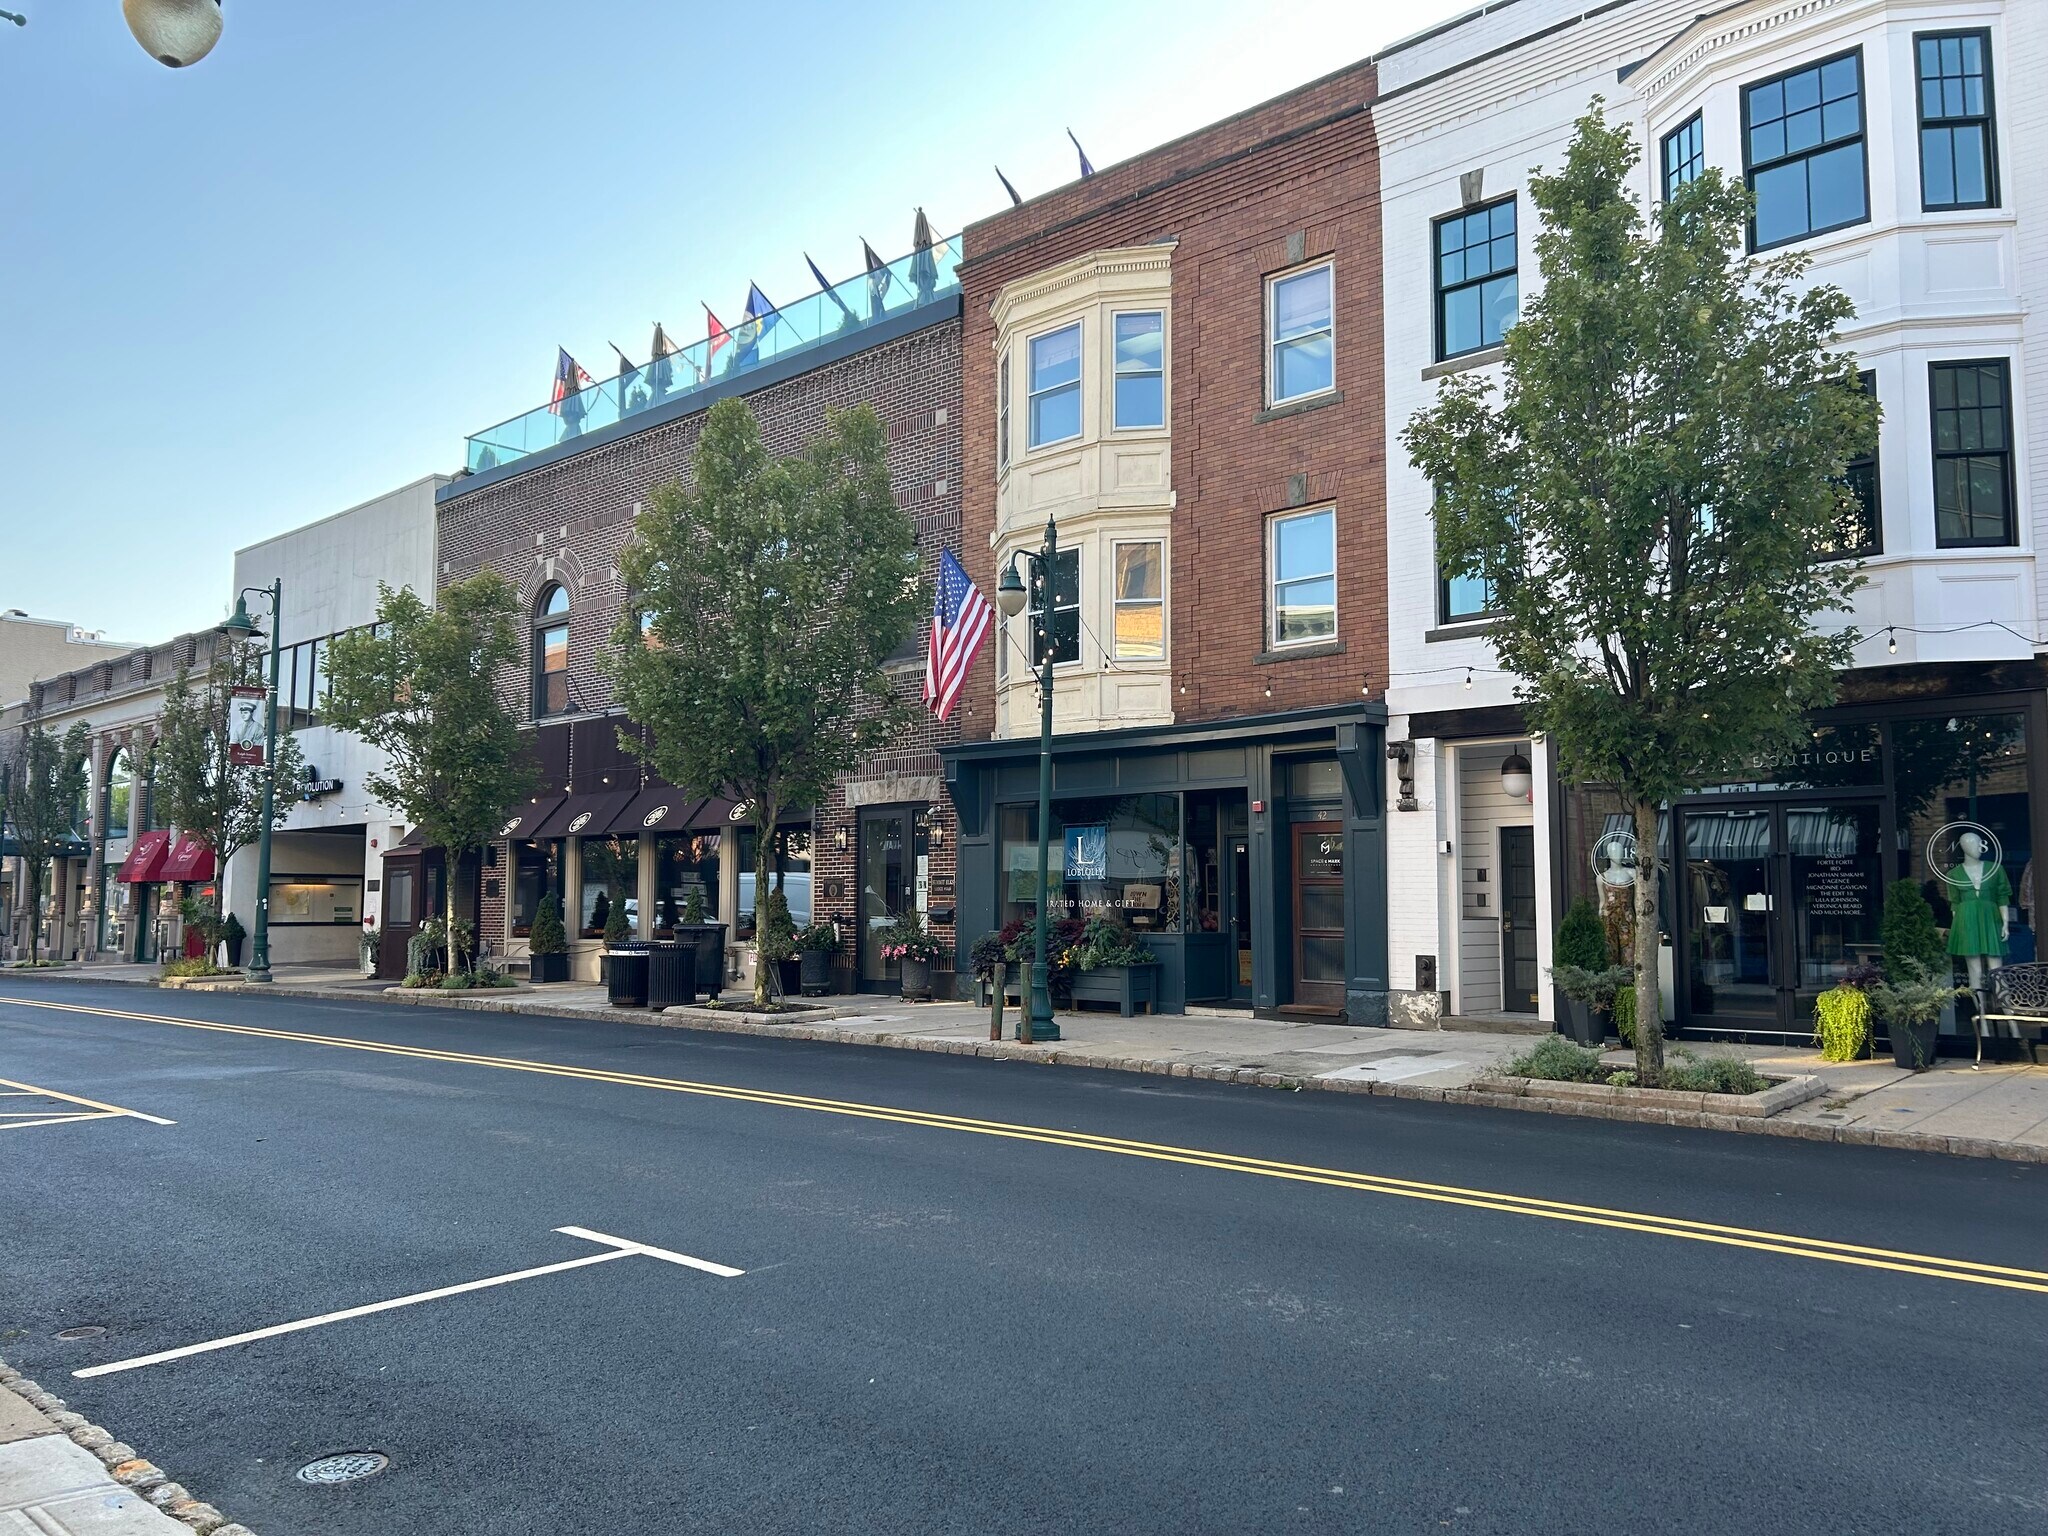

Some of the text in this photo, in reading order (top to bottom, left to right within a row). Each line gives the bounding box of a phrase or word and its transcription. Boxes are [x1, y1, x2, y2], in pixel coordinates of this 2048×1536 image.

[1318, 810, 1327, 820] 42
[1076, 836, 1094, 864] L
[1068, 868, 1104, 876] LOBLOLLY
[1115, 900, 1134, 908] GIFT
